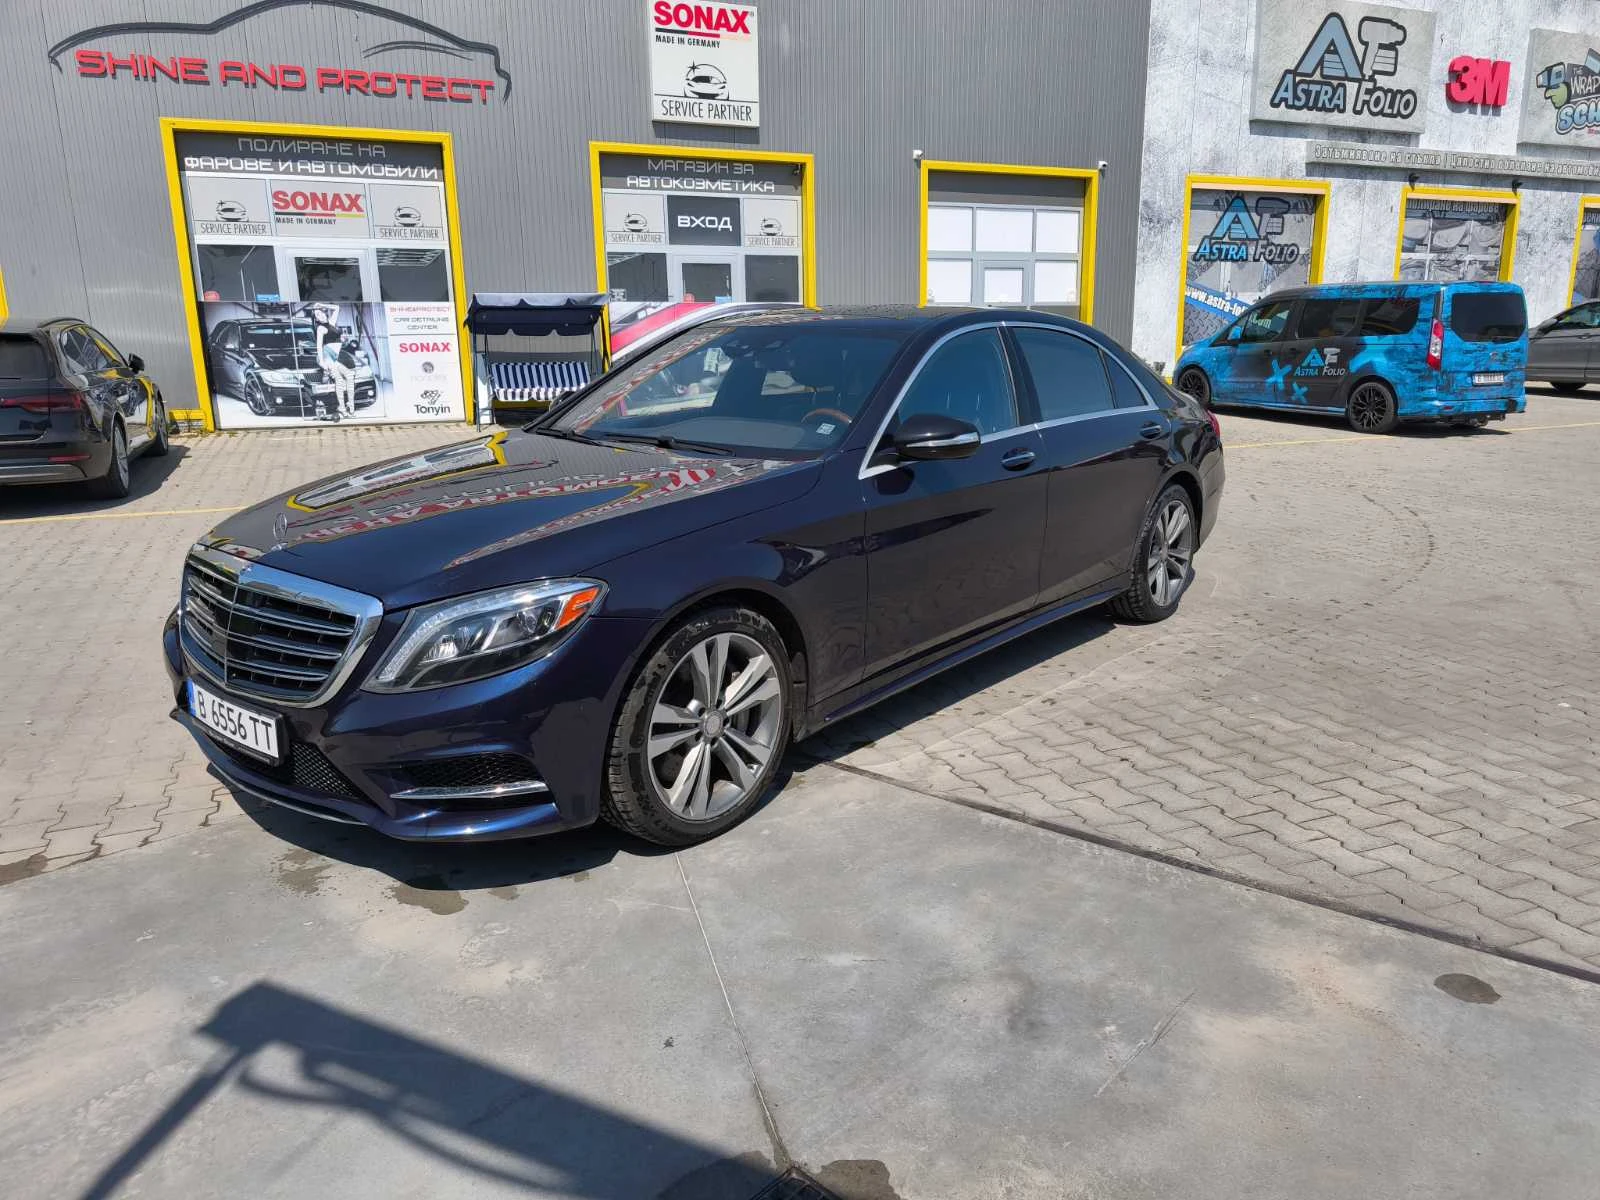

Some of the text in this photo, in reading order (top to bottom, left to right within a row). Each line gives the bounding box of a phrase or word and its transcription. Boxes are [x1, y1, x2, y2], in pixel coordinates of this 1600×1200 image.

[654, 1, 751, 34] SONAX
[655, 34, 721, 49] MADE IN GERMANY
[75, 49, 496, 102] SHINE AND PROTECT
[1447, 55, 1511, 106] 3M
[1270, 69, 1418, 119] ASTRA FOLIO
[662, 99, 752, 122] SERVICE PARTNER
[238, 137, 386, 158] ПОЛИРАНЕ НА
[184, 156, 439, 180] ФАРОВЕ И АВТОМОБИЛИ
[648, 159, 754, 175] МАГАЗИН ЗА
[627, 175, 775, 193] АВТОКОЗМЕТИКА
[271, 190, 364, 212] SONAX
[200, 223, 267, 235] SERVICE PARTNER
[275, 216, 337, 225] MADE IN GERMANY
[677, 215, 733, 231] ВХОД
[380, 228, 439, 240] SERVICE PARTNER
[611, 232, 663, 243] SERVICE PARTNER
[748, 236, 795, 247] SERVICE PARTNER
[1193, 235, 1300, 265] ASTRA FOLIO
[399, 342, 451, 353] SONAX
[1293, 366, 1346, 377] ASTRA FOLIO
[414, 404, 451, 416] Tonyin
[197, 691, 206, 719] B
[211, 698, 247, 740] 6556
[249, 715, 272, 751] TT
